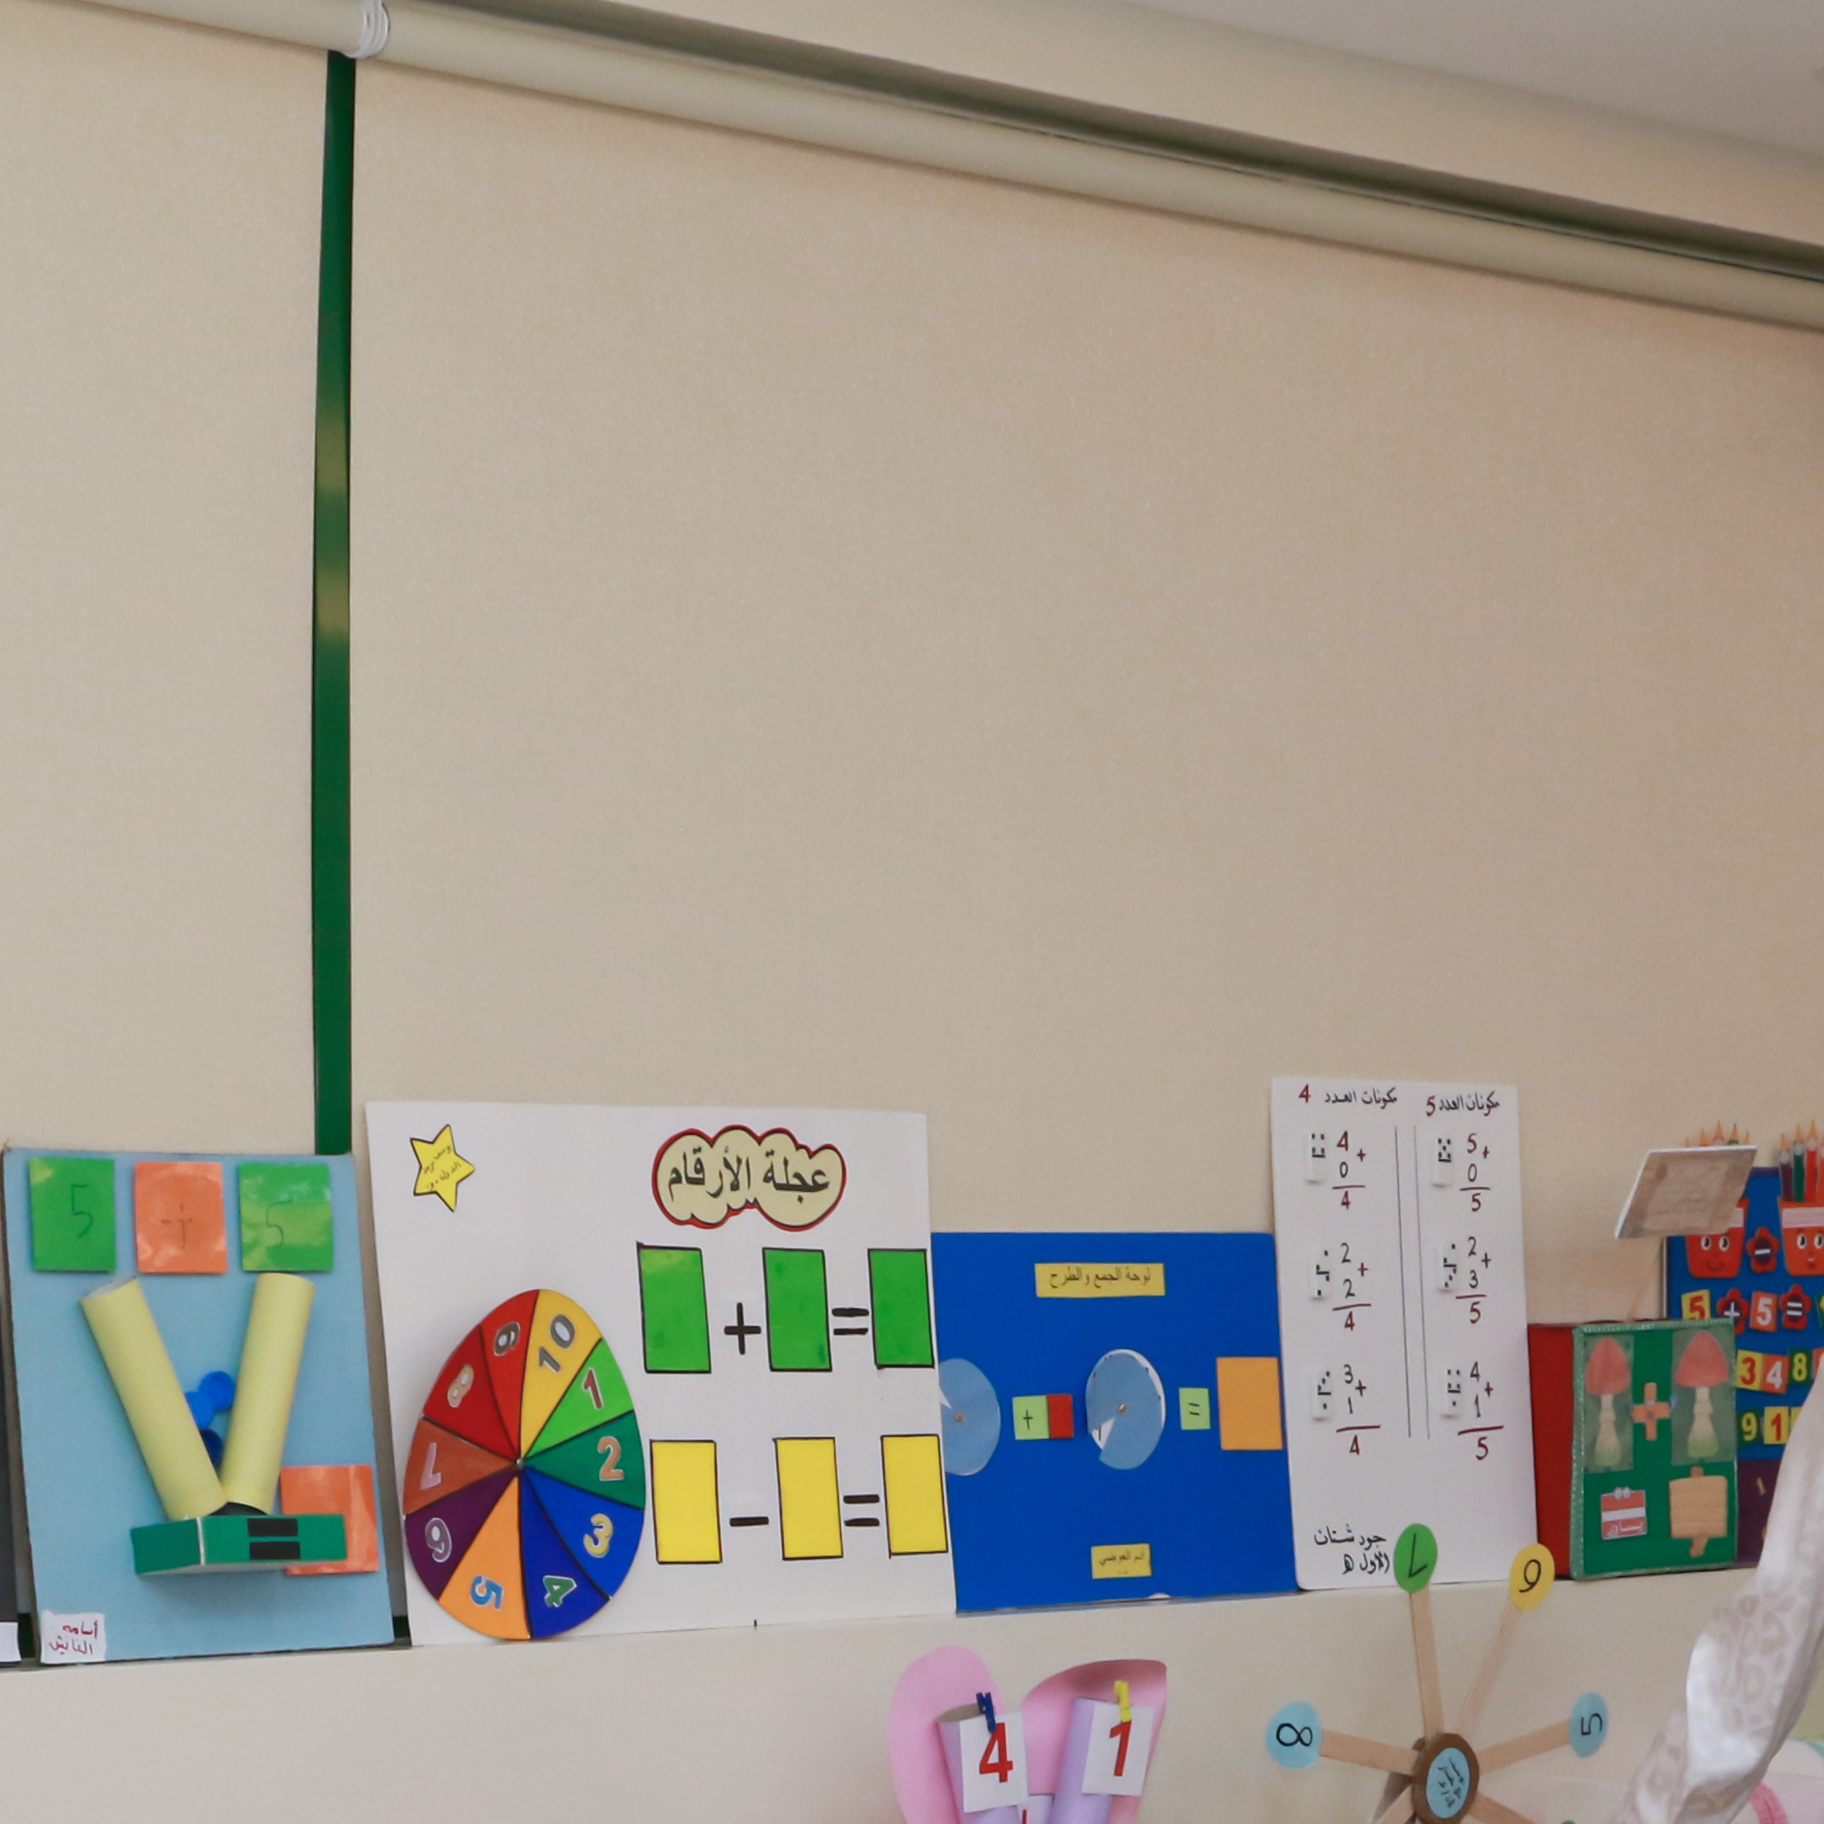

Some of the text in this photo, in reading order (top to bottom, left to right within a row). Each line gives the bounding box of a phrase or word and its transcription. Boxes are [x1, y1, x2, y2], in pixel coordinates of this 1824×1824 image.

[1299, 1083, 1311, 1104] 4
[1426, 1095, 1436, 1117] 5
[1336, 1130, 1349, 1151] 4
[1467, 1133, 1477, 1153] 5
[668, 1146, 830, 1204] عجلة الأرقام
[1340, 1190, 1351, 1210] 4
[1471, 1192, 1481, 1212] 5
[1757, 1297, 1773, 1325] 5
[538, 1313, 576, 1374] 10
[1343, 1364, 1354, 1385] 3
[1469, 1361, 1481, 1382] 4
[1740, 1357, 1757, 1385] 3
[1766, 1361, 1783, 1390] 4
[1792, 1352, 1808, 1381] 8
[582, 1368, 604, 1410] 1
[1741, 1412, 1758, 1441] 9
[596, 1435, 625, 1482] 2
[1349, 1435, 1361, 1456] 4
[1475, 1437, 1489, 1460] 5
[583, 1512, 613, 1557] 3
[979, 1722, 1013, 1783] 4
[1109, 1719, 1133, 1777] 1
